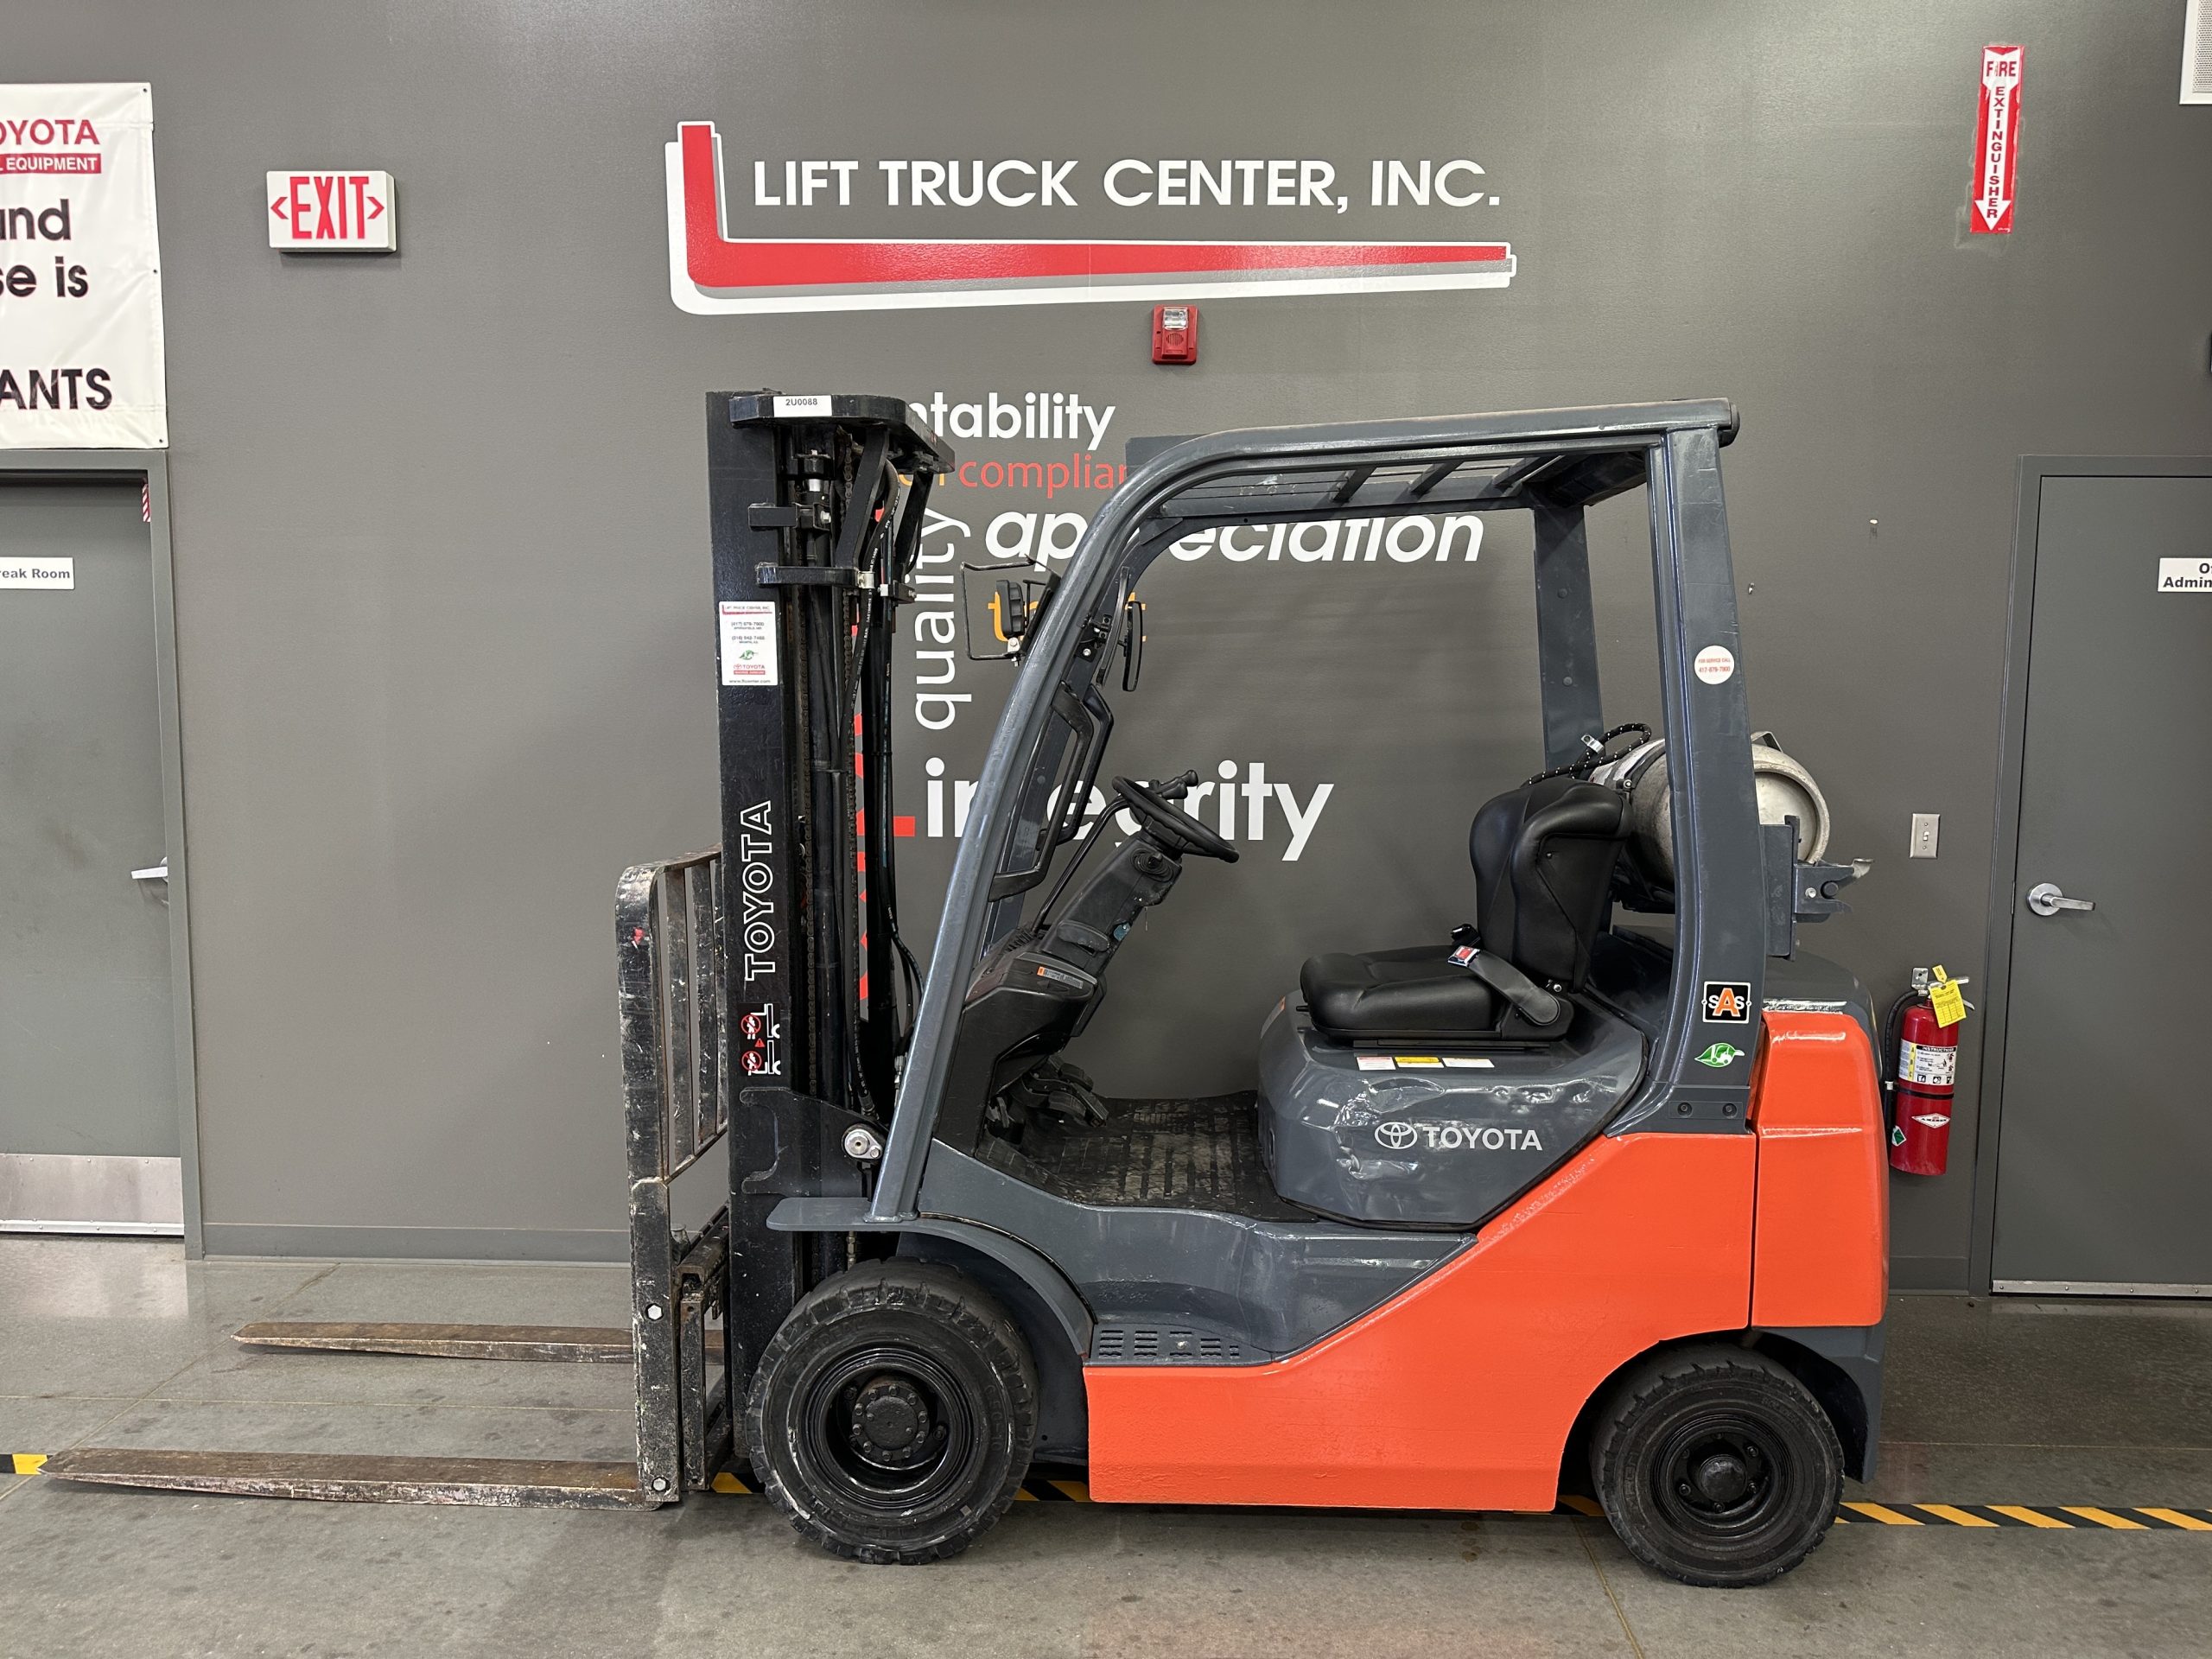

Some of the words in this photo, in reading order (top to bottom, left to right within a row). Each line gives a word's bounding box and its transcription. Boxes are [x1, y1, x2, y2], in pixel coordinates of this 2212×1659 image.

[1986, 60, 2017, 77] FIRE
[0, 118, 100, 146] YOTA
[1986, 86, 2005, 219] EXTINGUISHER
[6, 157, 98, 171] EQUIPMENT
[289, 176, 370, 239] EXIT
[753, 161, 858, 207] LIFT
[878, 161, 1077, 207] TRUCK
[1103, 161, 1348, 213] CENTER,
[1370, 161, 1501, 207] INC.
[0, 198, 71, 241] nd
[0, 264, 37, 297] e
[54, 256, 89, 298] is
[0, 368, 112, 410] ANTS
[958, 453, 1127, 499] complia
[985, 511, 1484, 572] apeciation
[0, 568, 27, 578] eak
[32, 569, 70, 579] Room
[2163, 576, 2212, 588] Admin
[2199, 563, 2212, 574] O
[905, 507, 972, 730] quality
[925, 757, 1335, 861] ierity
[741, 800, 776, 982] TOYOTA
[1422, 1126, 1543, 1151] TOYOTA
